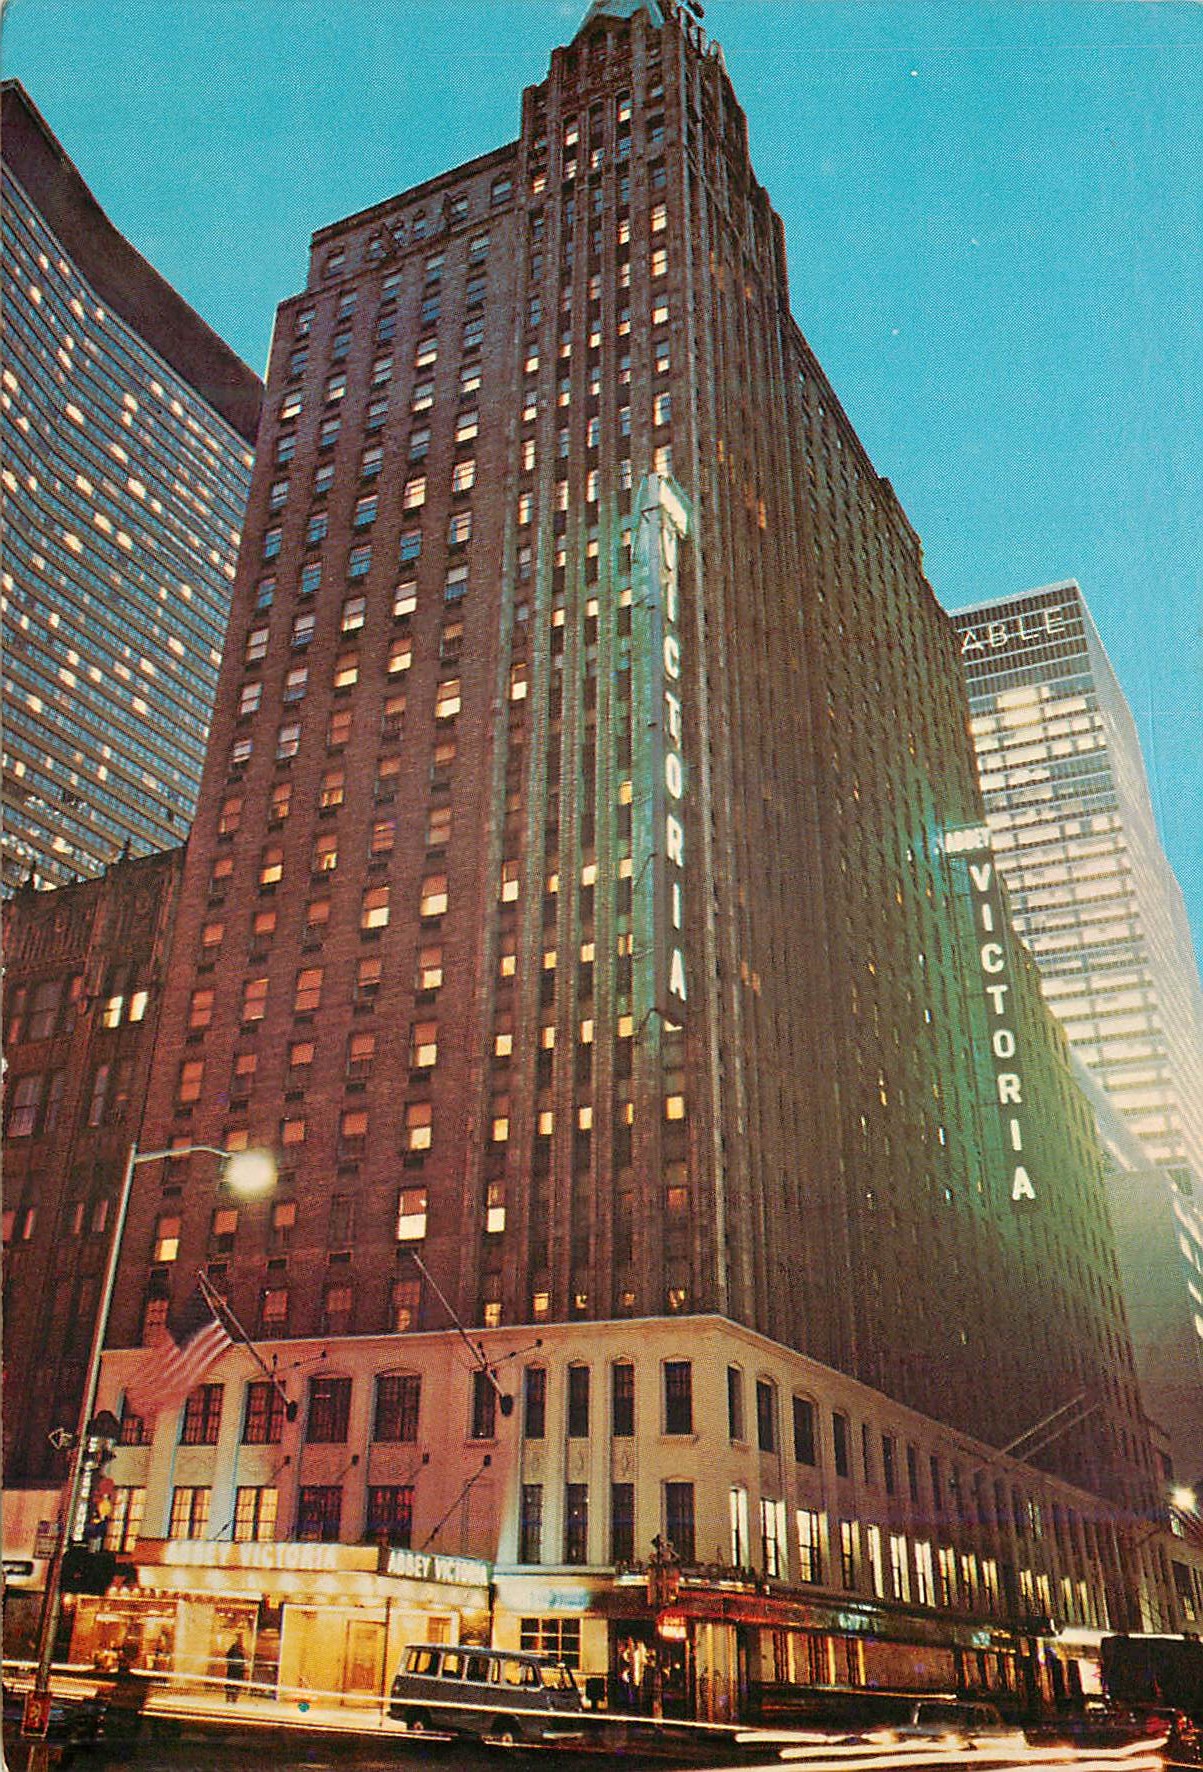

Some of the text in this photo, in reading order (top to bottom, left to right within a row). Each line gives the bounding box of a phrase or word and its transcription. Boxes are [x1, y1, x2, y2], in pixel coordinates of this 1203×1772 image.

[661, 514, 687, 1001] VICTORIA
[960, 608, 1065, 655] ABLE
[969, 863, 1036, 1201] VICTORIA
